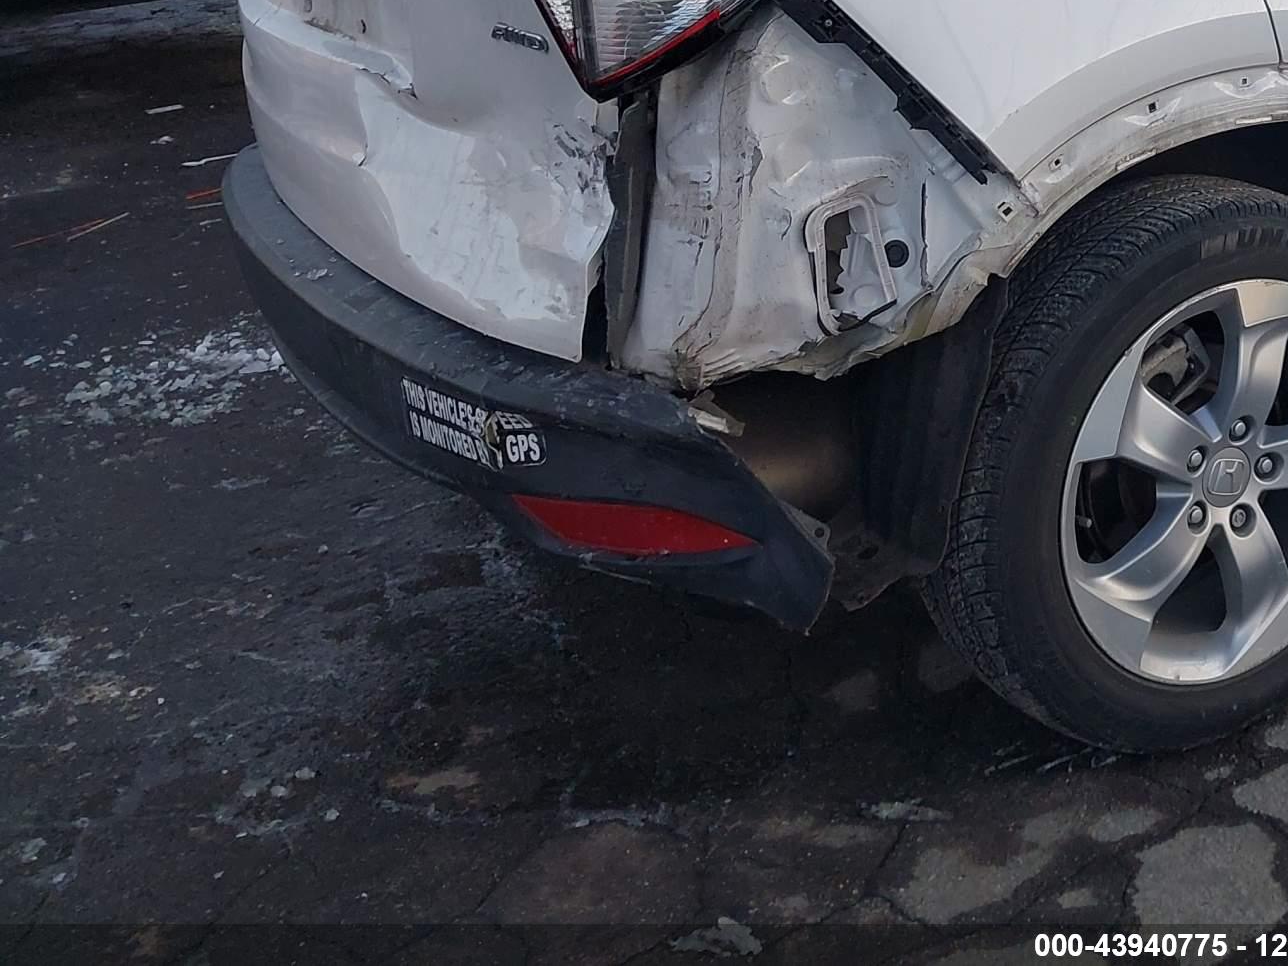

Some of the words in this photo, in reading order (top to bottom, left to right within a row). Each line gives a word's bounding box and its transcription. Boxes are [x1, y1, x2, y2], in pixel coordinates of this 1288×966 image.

[491, 23, 549, 54] AWD
[402, 378, 427, 411] THIS
[424, 387, 475, 432] VEHICLE'S
[409, 410, 421, 438] IS
[419, 415, 479, 461] MONITORED
[505, 432, 541, 463] GPS
